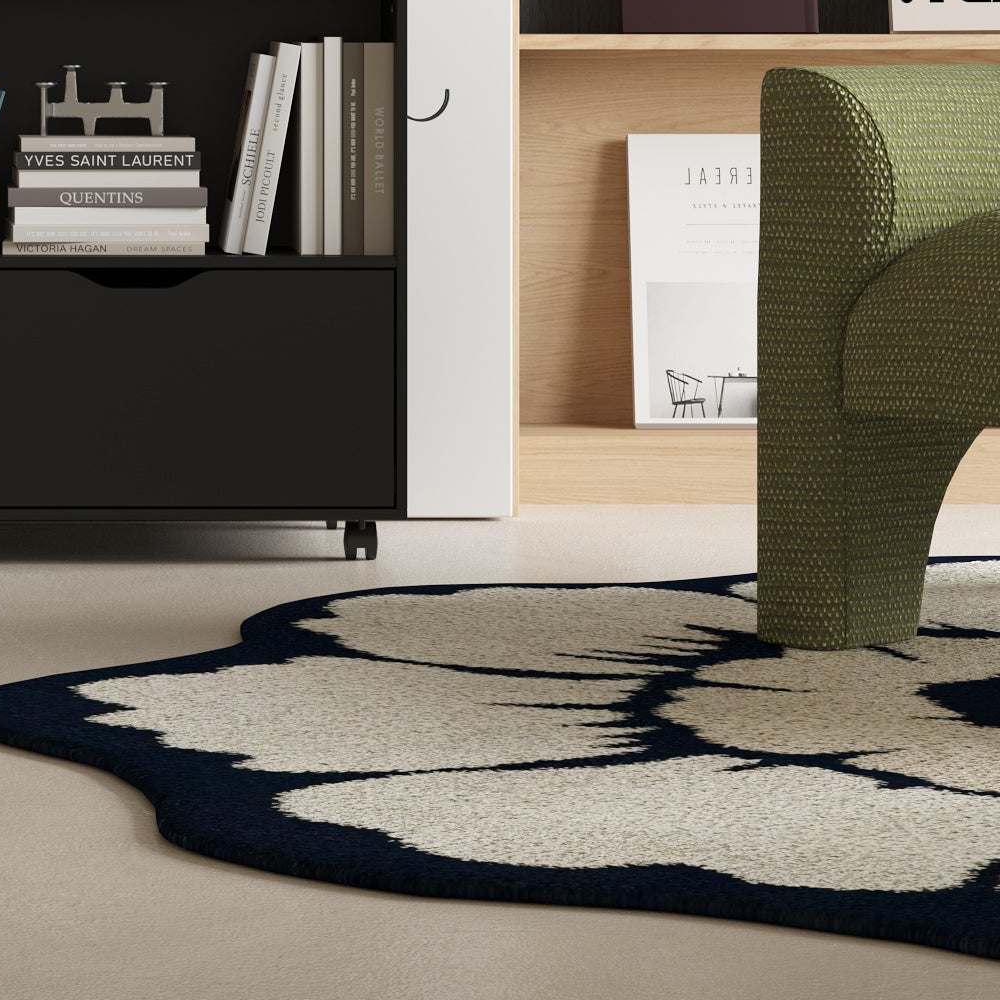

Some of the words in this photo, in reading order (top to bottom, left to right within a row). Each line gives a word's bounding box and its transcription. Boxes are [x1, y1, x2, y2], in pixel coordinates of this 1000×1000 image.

[374, 106, 385, 149] WORLD
[24, 154, 65, 167] YVES
[70, 154, 117, 167] SAINT
[122, 154, 194, 167] LAURENT
[242, 128, 261, 186] SCHIELE
[374, 153, 385, 195] BALLET
[59, 191, 144, 205] QUENTINS
[16, 244, 67, 253] VICTORIA
[70, 244, 107, 253] HAGAN
